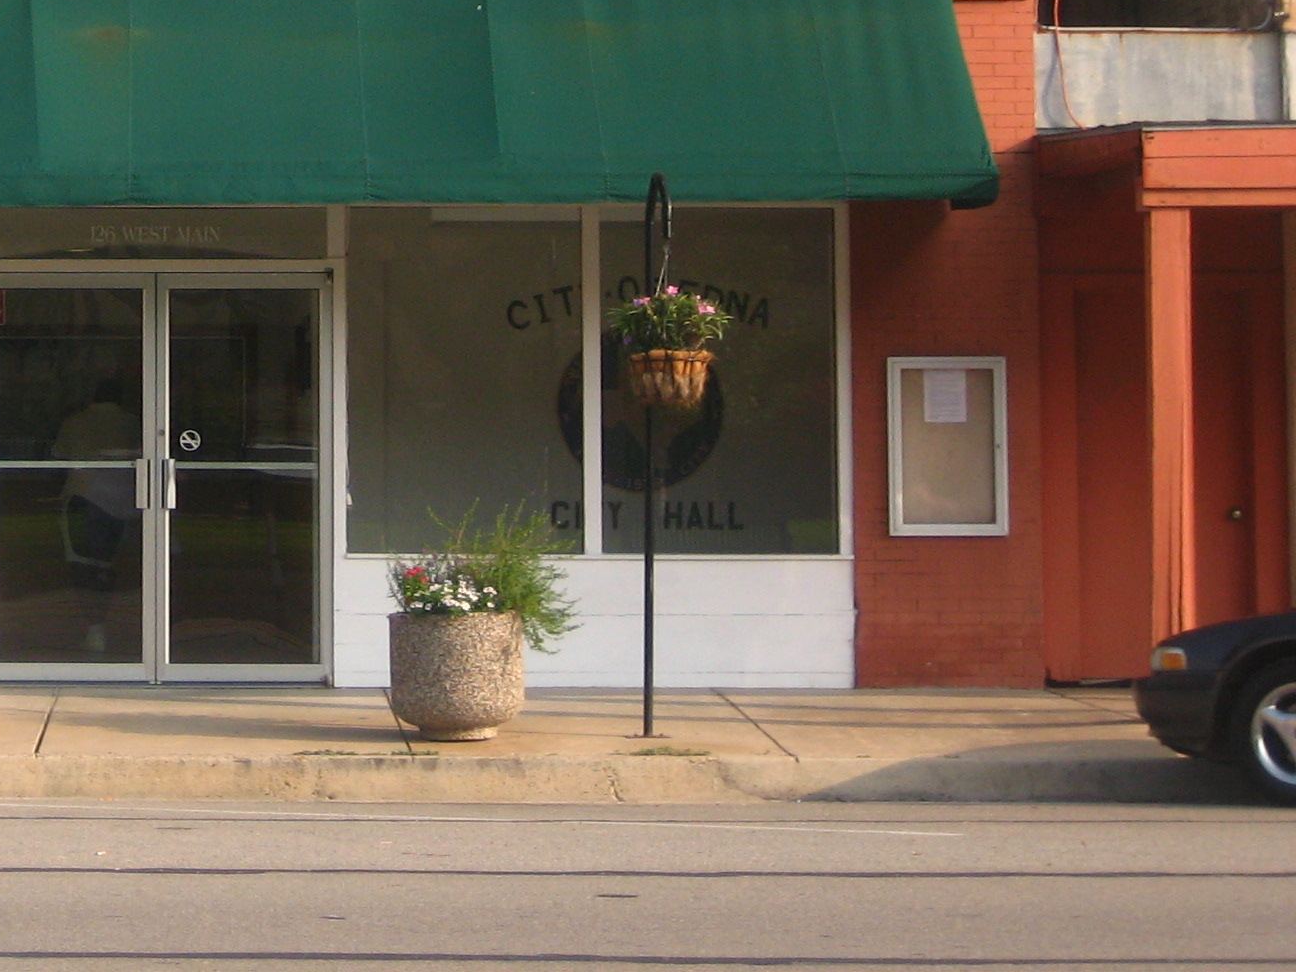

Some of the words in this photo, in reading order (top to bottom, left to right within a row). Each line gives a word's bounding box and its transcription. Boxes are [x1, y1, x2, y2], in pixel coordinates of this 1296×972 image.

[122, 225, 170, 243] WEST
[177, 225, 221, 243] MAIN
[506, 284, 612, 330] CIT
[551, 501, 624, 530] CIY
[663, 501, 744, 530] HALL
